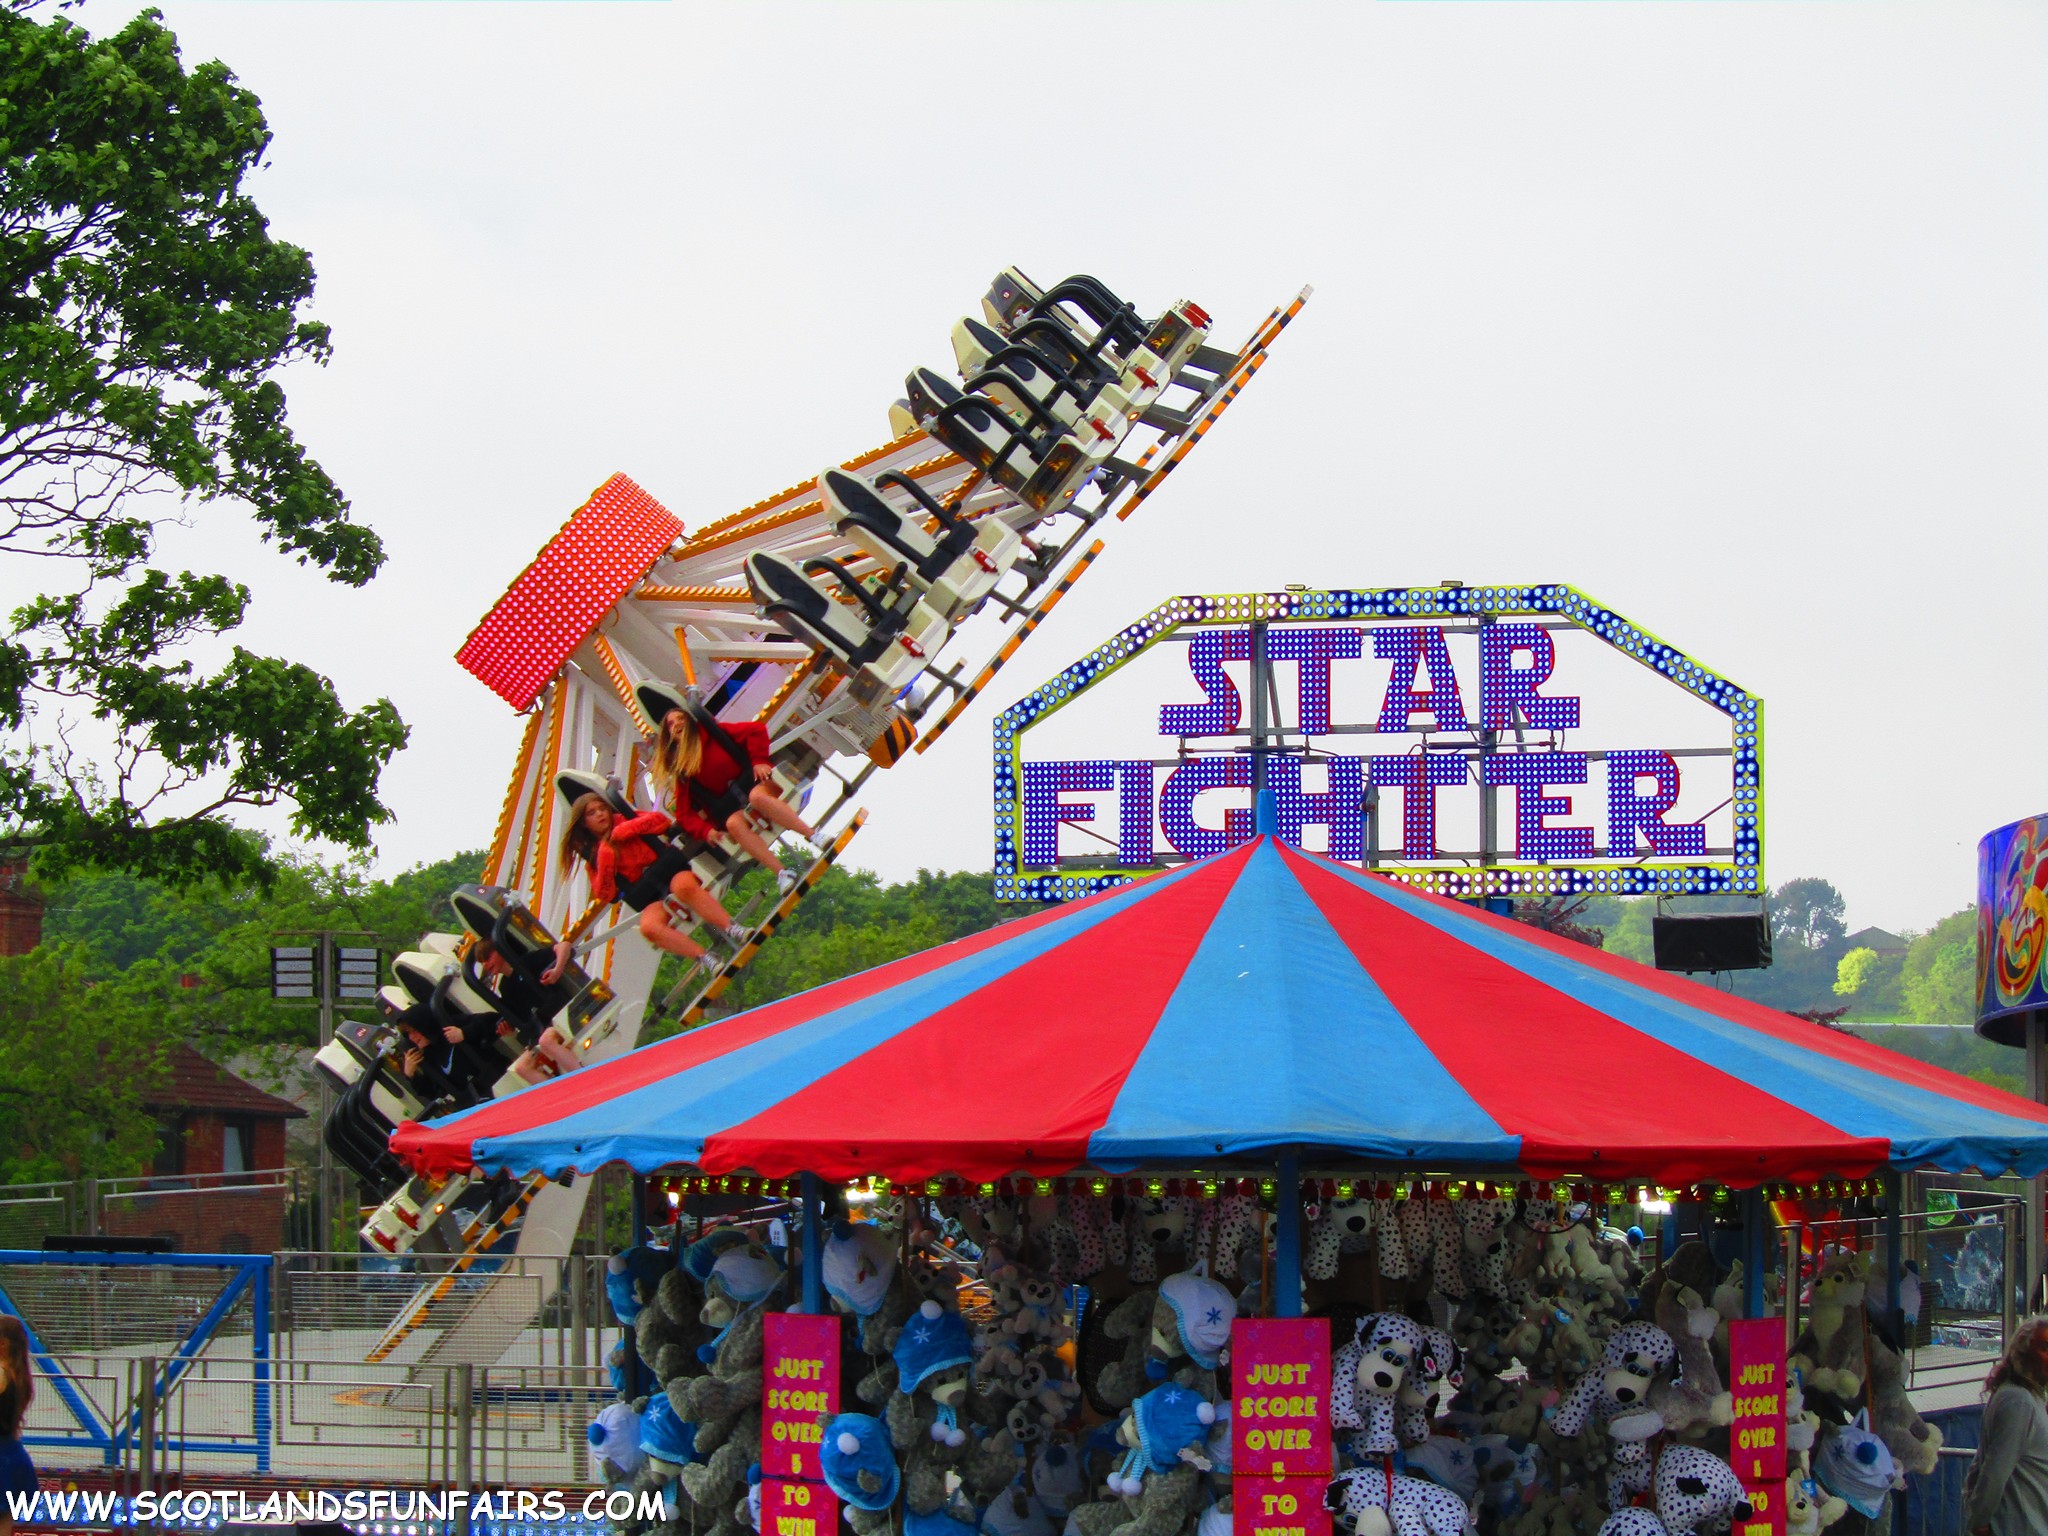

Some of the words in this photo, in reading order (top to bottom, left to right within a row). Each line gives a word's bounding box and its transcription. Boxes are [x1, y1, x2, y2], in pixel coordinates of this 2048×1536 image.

[1159, 622, 1580, 735] STAR
[1021, 750, 1706, 865] FIGHTER
[773, 1357, 824, 1380] JUST
[1246, 1363, 1311, 1385] JUST
[1738, 1363, 1775, 1386] JUST
[768, 1389, 829, 1412] SCORE
[1239, 1396, 1318, 1418] SCORE
[1735, 1394, 1779, 1418] SCORE
[771, 1421, 823, 1443] OVER
[1245, 1428, 1312, 1450] OVER
[1738, 1426, 1776, 1449] OVER
[791, 1453, 802, 1474] 5
[1272, 1461, 1285, 1483] 5
[782, 1485, 810, 1506] TO
[1261, 1494, 1297, 1515] TO
[1749, 1491, 1768, 1512] TO
